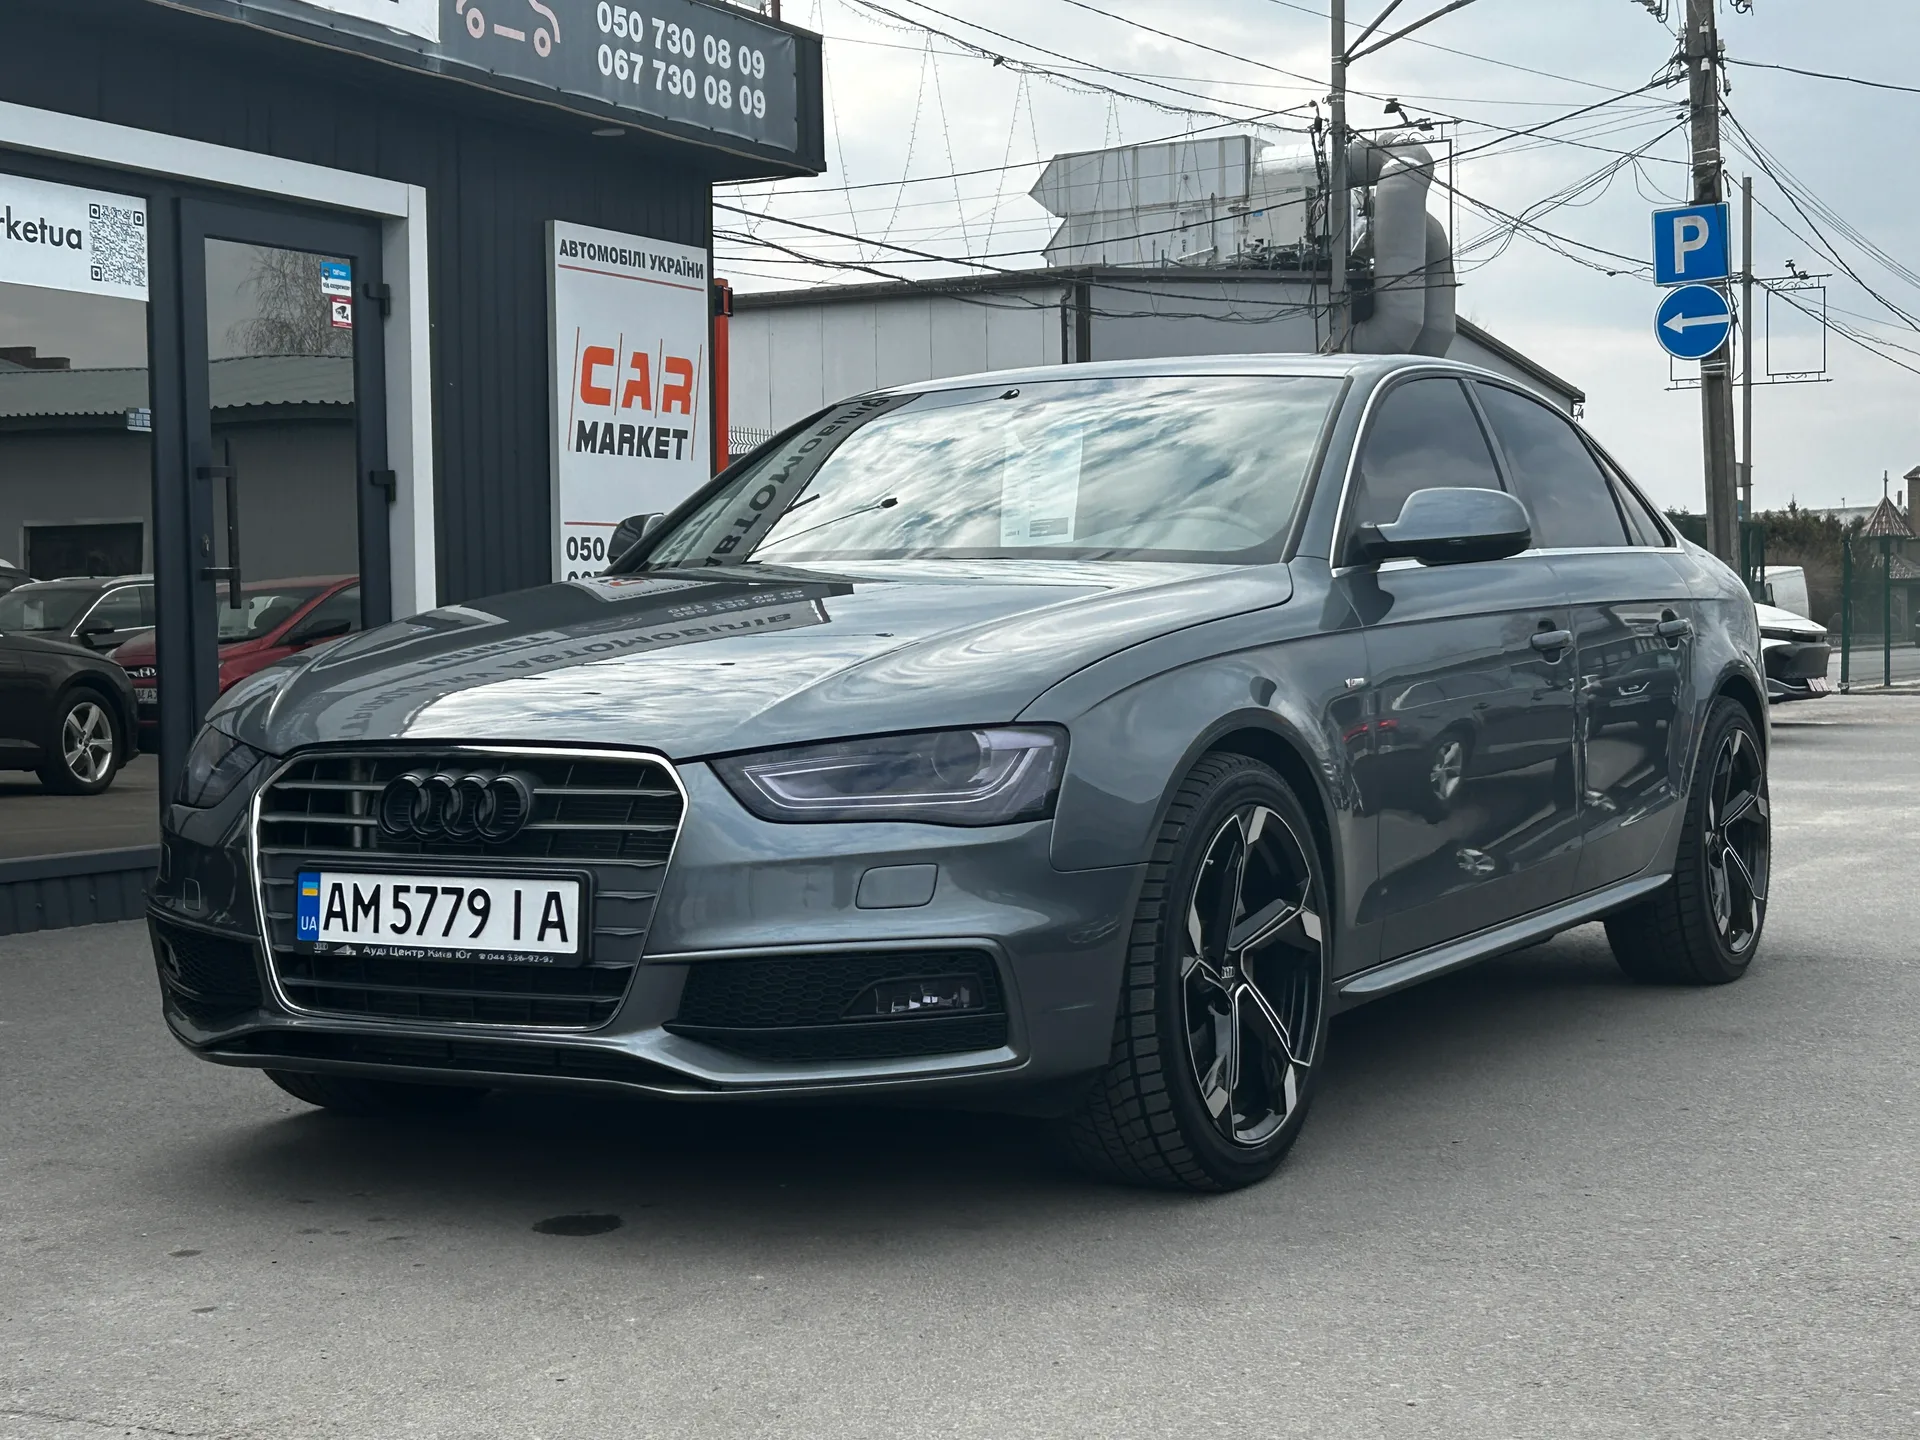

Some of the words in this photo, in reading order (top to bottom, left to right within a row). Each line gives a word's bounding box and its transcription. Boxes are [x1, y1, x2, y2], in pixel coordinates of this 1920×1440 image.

[597, 2, 643, 43] 050
[652, 17, 696, 58] 730
[703, 34, 732, 69] 08
[738, 45, 766, 79] 09
[597, 43, 643, 84] 067
[652, 58, 696, 99] 730
[703, 74, 732, 109] 08
[739, 85, 766, 119] 09
[559, 239, 646, 269] АВТОМОБІЛІ
[649, 255, 704, 279] УКРАЇНИ
[1673, 215, 1709, 274] P
[580, 345, 693, 415] CAR
[575, 420, 688, 460] MARKET
[566, 536, 605, 561] 050
[301, 916, 317, 931] UA
